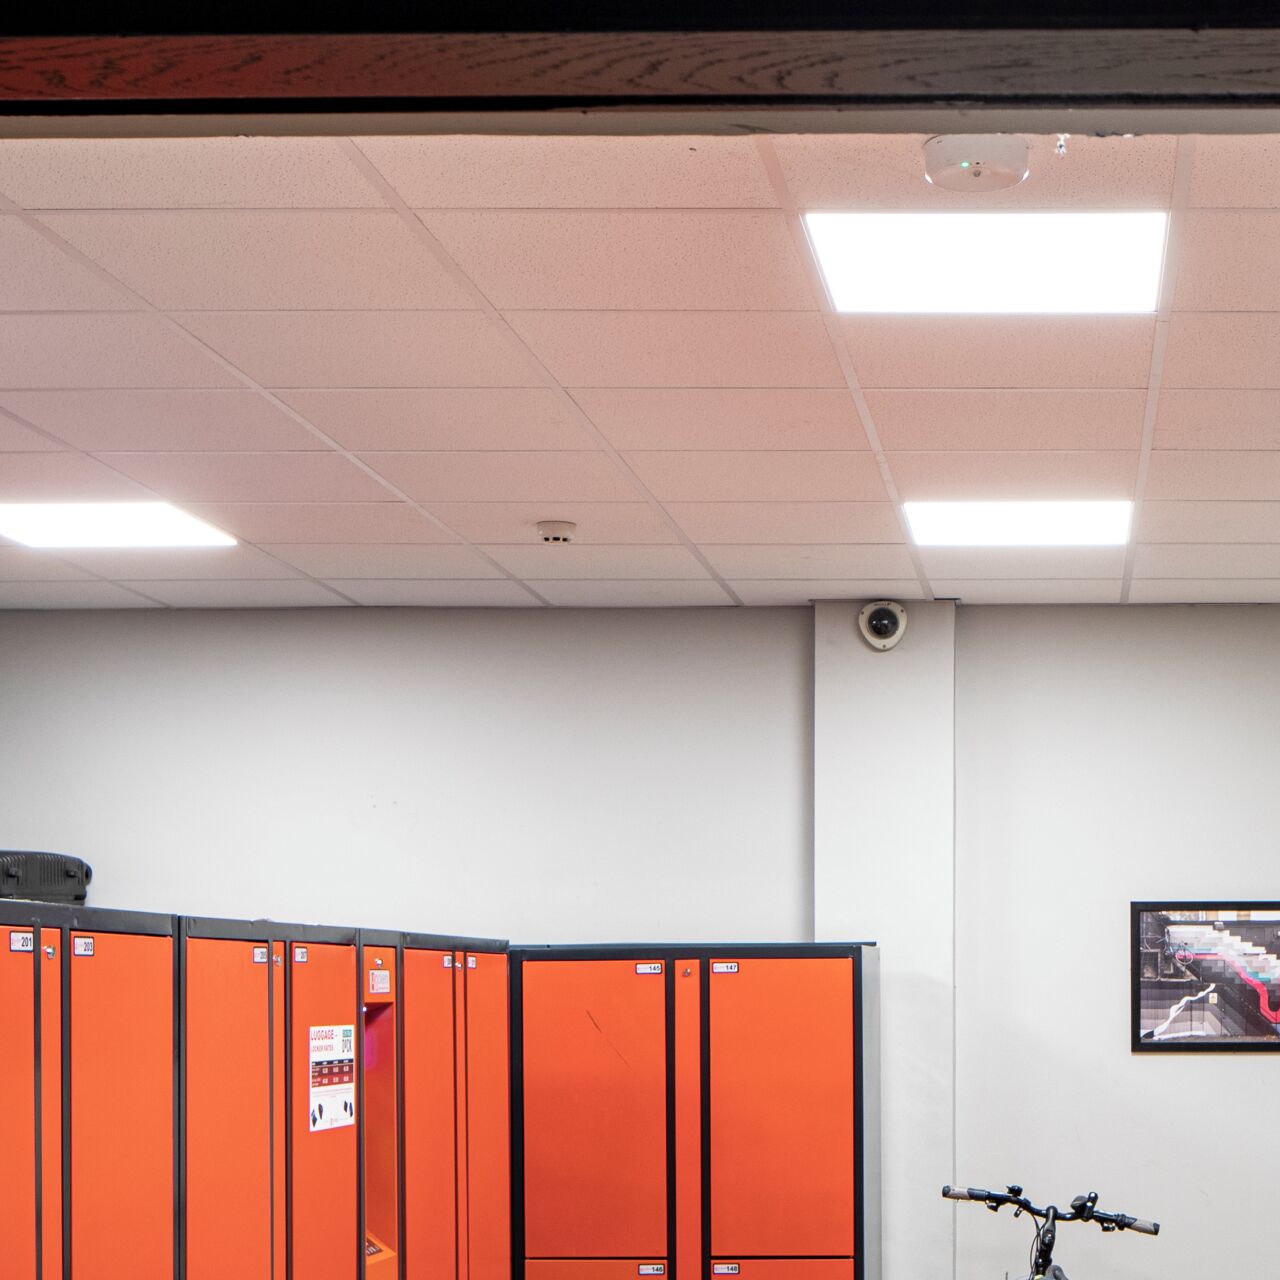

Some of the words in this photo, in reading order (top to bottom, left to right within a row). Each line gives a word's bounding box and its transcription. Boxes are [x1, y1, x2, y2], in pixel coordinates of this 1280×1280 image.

[21, 936, 32, 947] 201
[83, 942, 93, 952] 203
[311, 1030, 334, 1040] LUGGAGE
